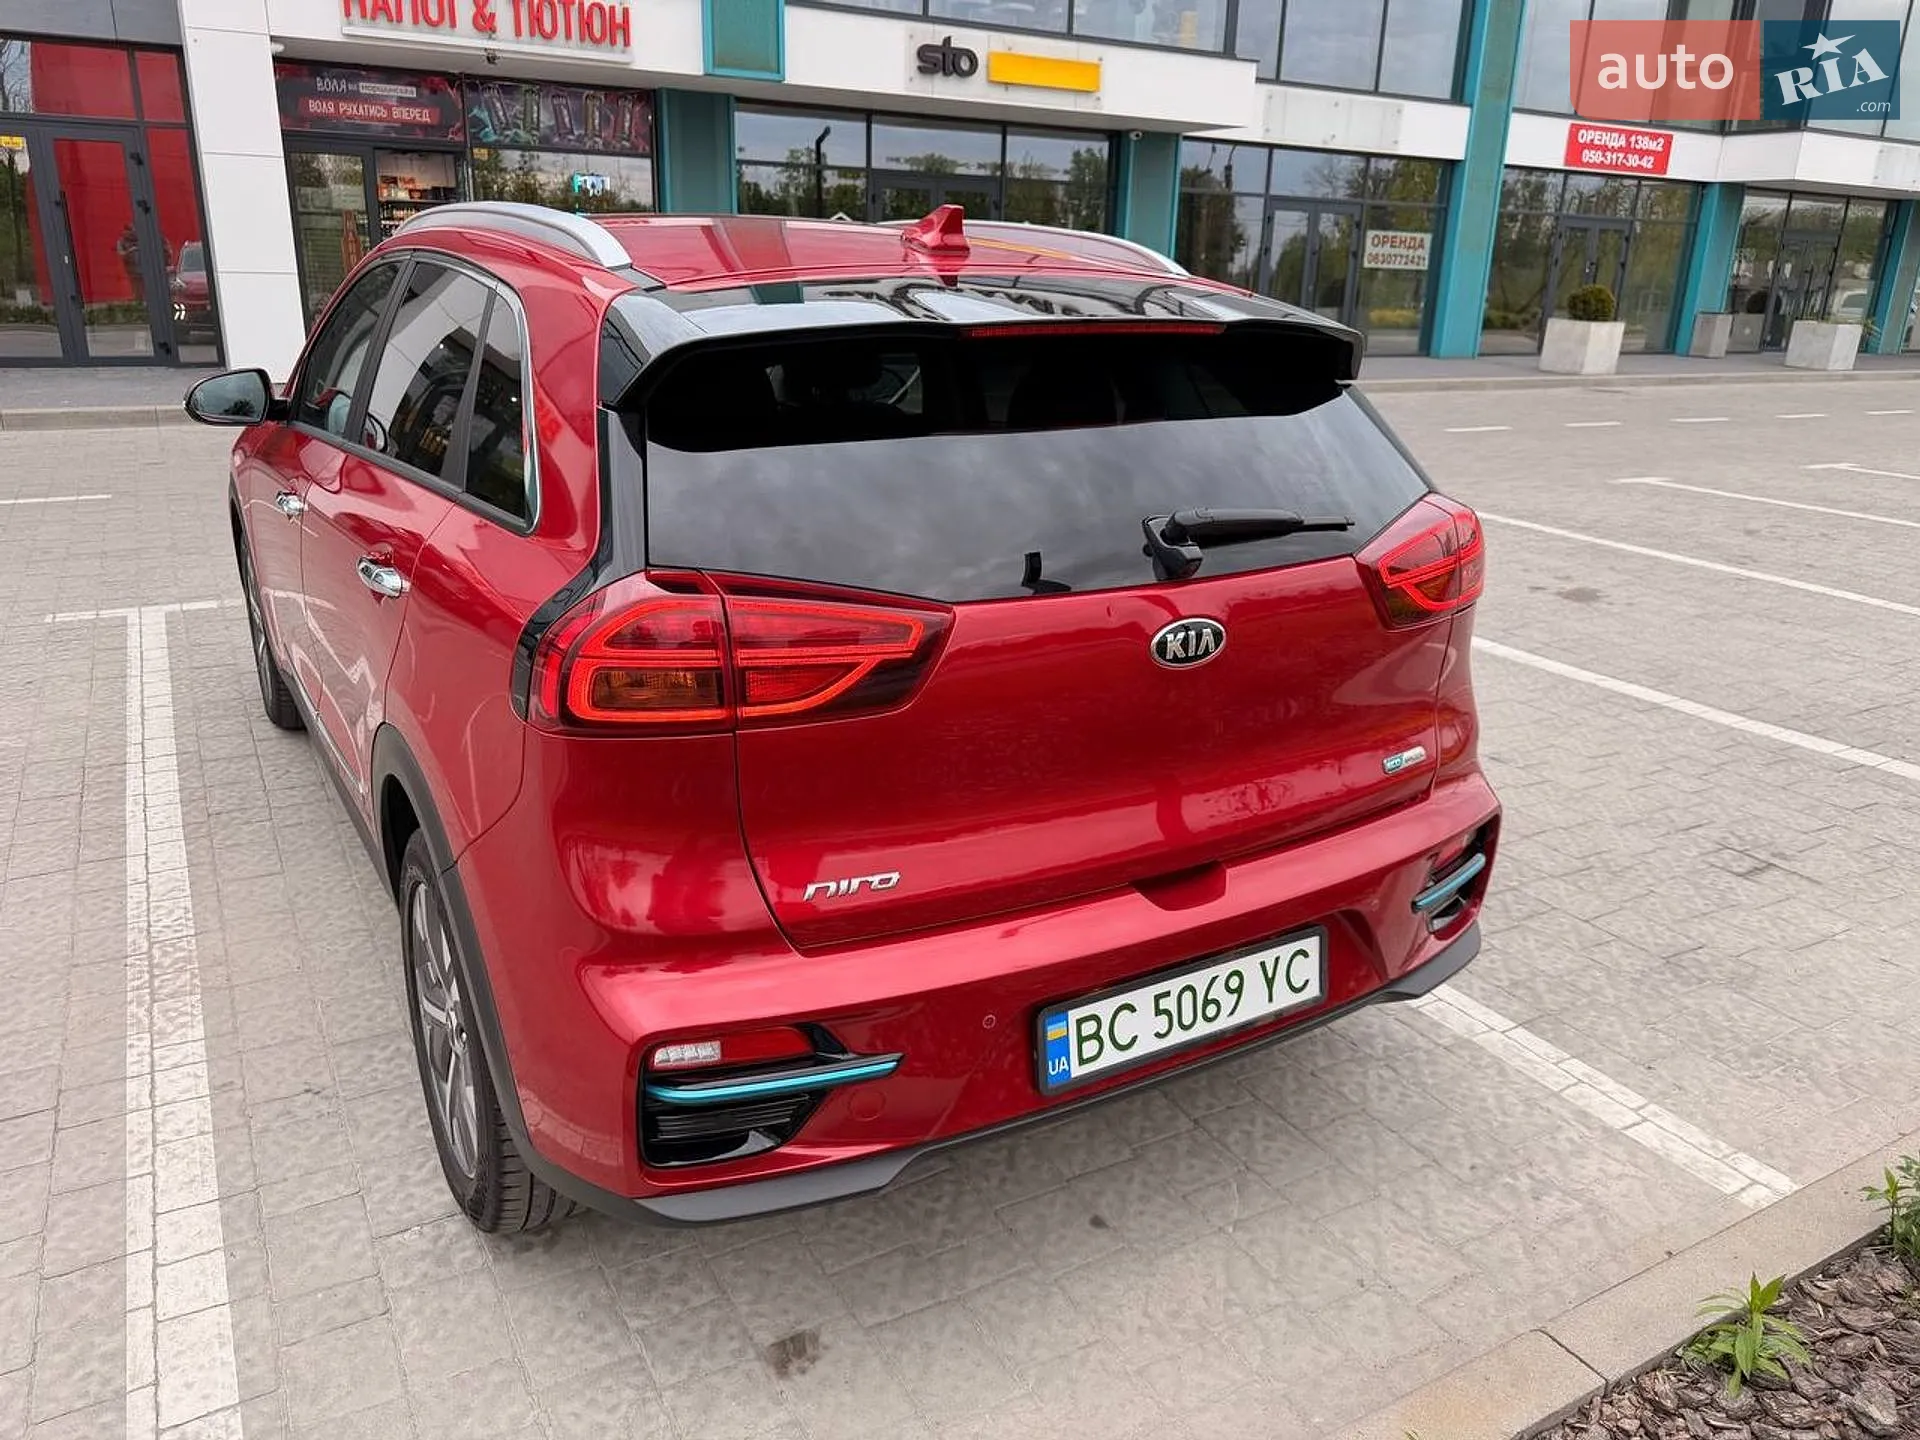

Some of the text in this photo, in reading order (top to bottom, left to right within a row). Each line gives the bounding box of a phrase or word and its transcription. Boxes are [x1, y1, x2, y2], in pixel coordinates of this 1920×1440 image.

[472, 0, 497, 33] &
[511, 0, 631, 48] ТЮТЮН
[916, 35, 979, 78] sto
[316, 76, 347, 94] ВОЛЯ
[308, 99, 431, 123] ВОЛЯ РУХАТИСЬ ВПЕРЕД
[1578, 129, 1626, 149] ОРЕНДА
[1371, 233, 1425, 251] ОРЕНДА
[1165, 628, 1215, 660] KIA
[803, 871, 901, 901] niro
[1075, 948, 1310, 1067] BC 5069 YC
[1049, 1055, 1069, 1076] UA
